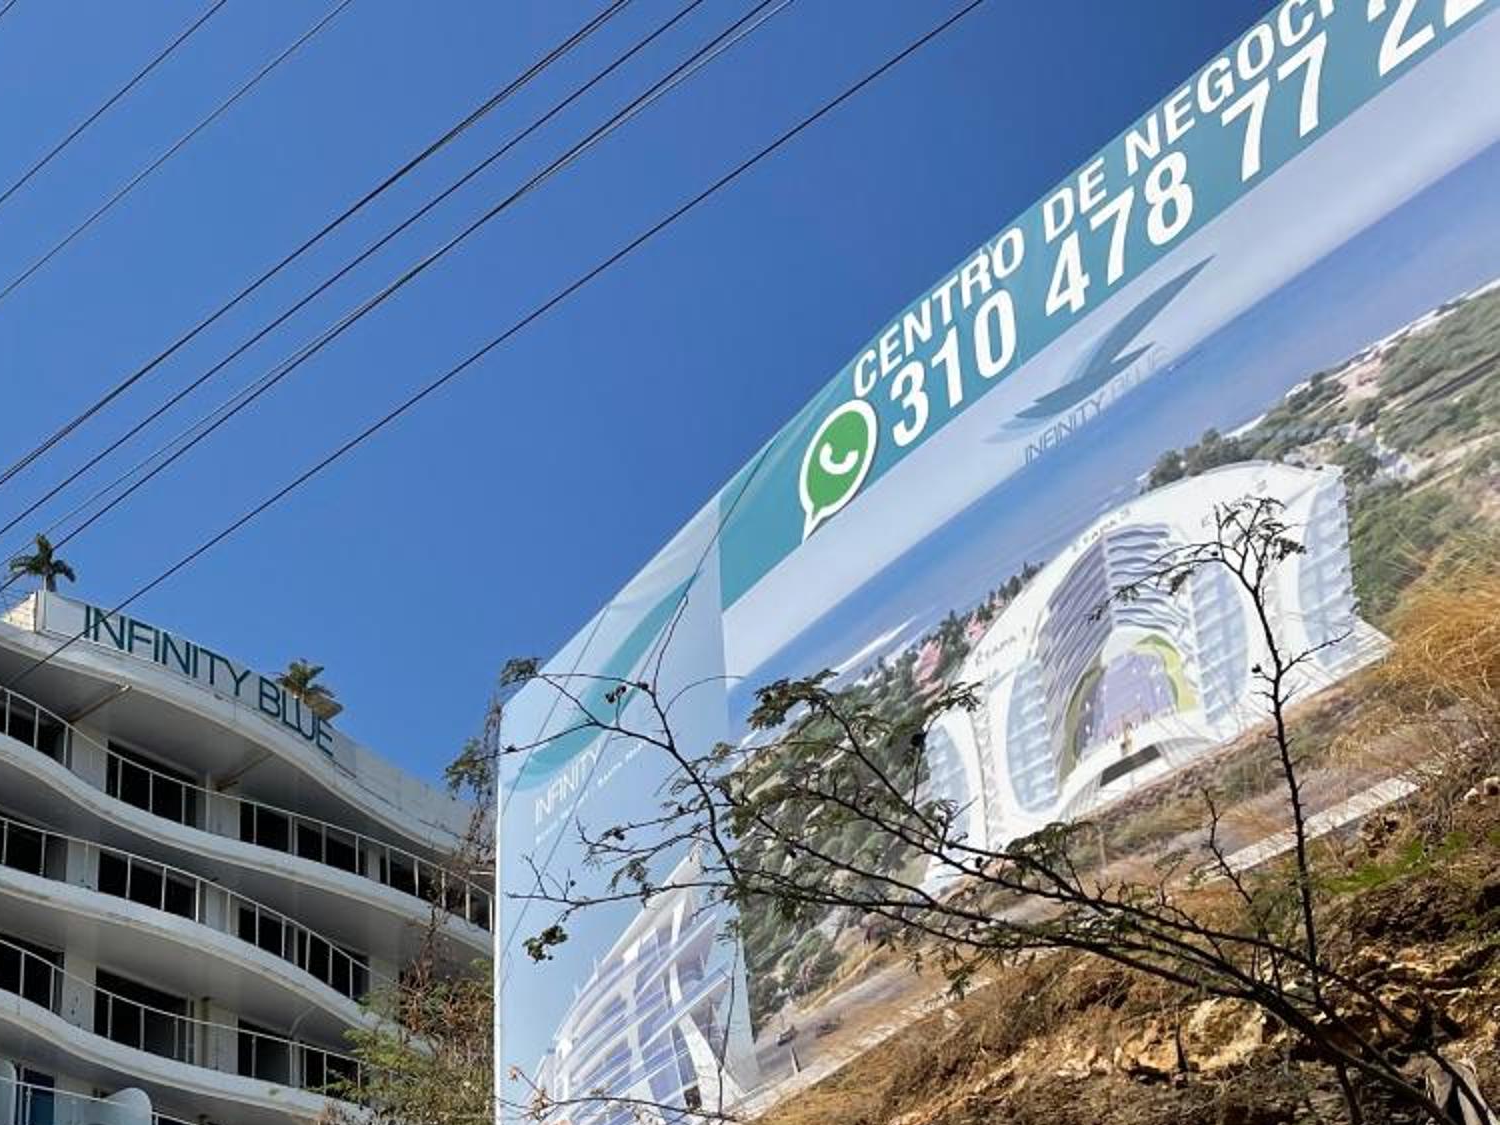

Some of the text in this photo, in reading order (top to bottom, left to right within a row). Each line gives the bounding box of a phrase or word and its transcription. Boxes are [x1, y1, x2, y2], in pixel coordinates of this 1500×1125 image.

[853, 226, 1025, 398] CENTRO
[1042, 156, 1108, 244] DE
[889, 288, 1017, 448] 310
[1044, 150, 1194, 317] 478
[1220, 30, 1328, 183] 77
[1024, 391, 1106, 466] INFINITY
[83, 604, 334, 758] INFINITY BLUE
